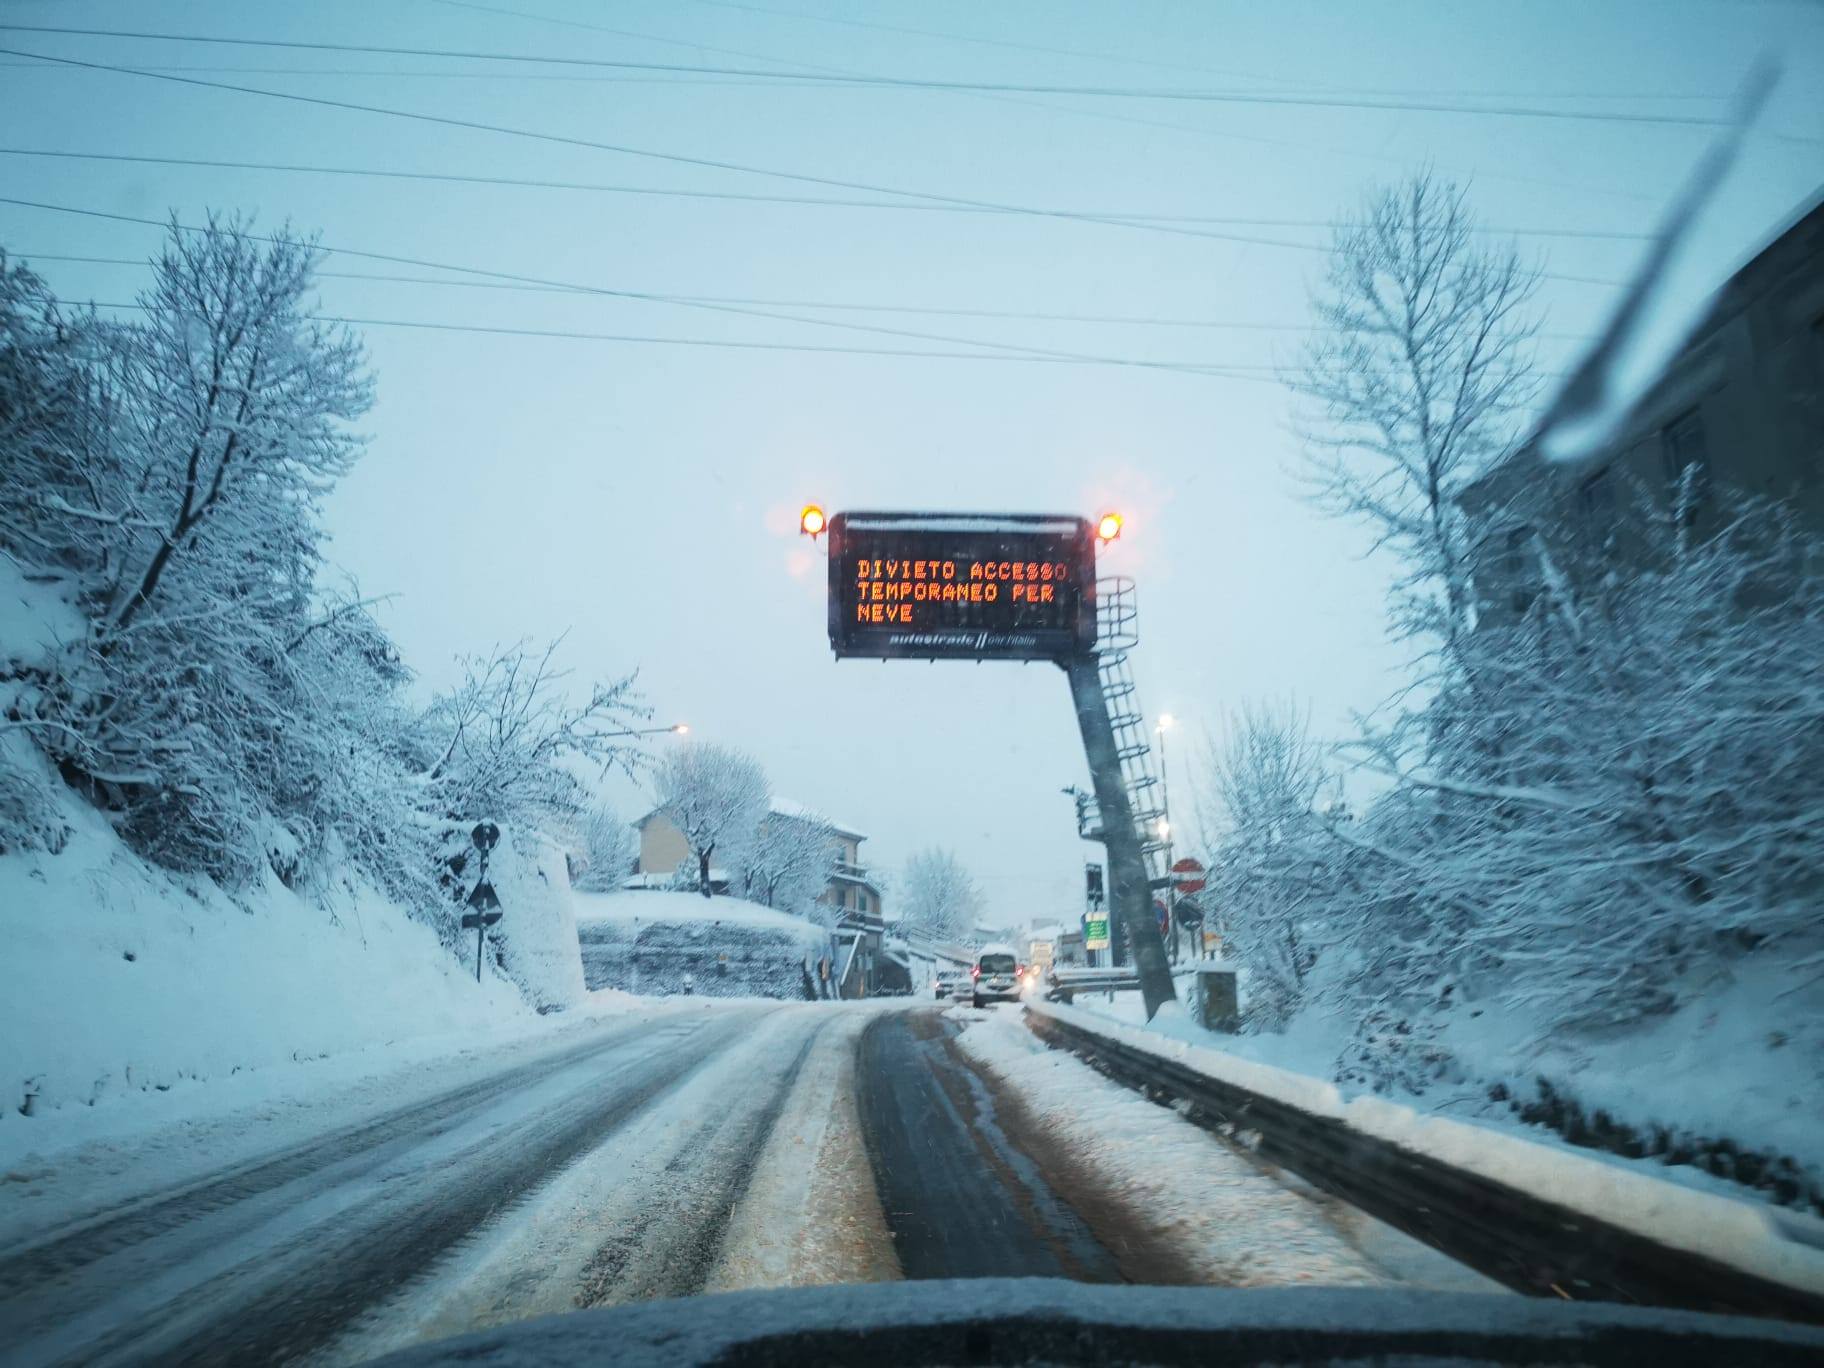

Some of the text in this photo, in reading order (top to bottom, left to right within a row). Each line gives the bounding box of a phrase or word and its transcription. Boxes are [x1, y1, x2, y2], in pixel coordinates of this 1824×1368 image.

[857, 560, 1067, 580] DIVIETO ACCESSO
[857, 582, 1055, 602] TEMPORANEO PER
[857, 604, 913, 622] NEVE
